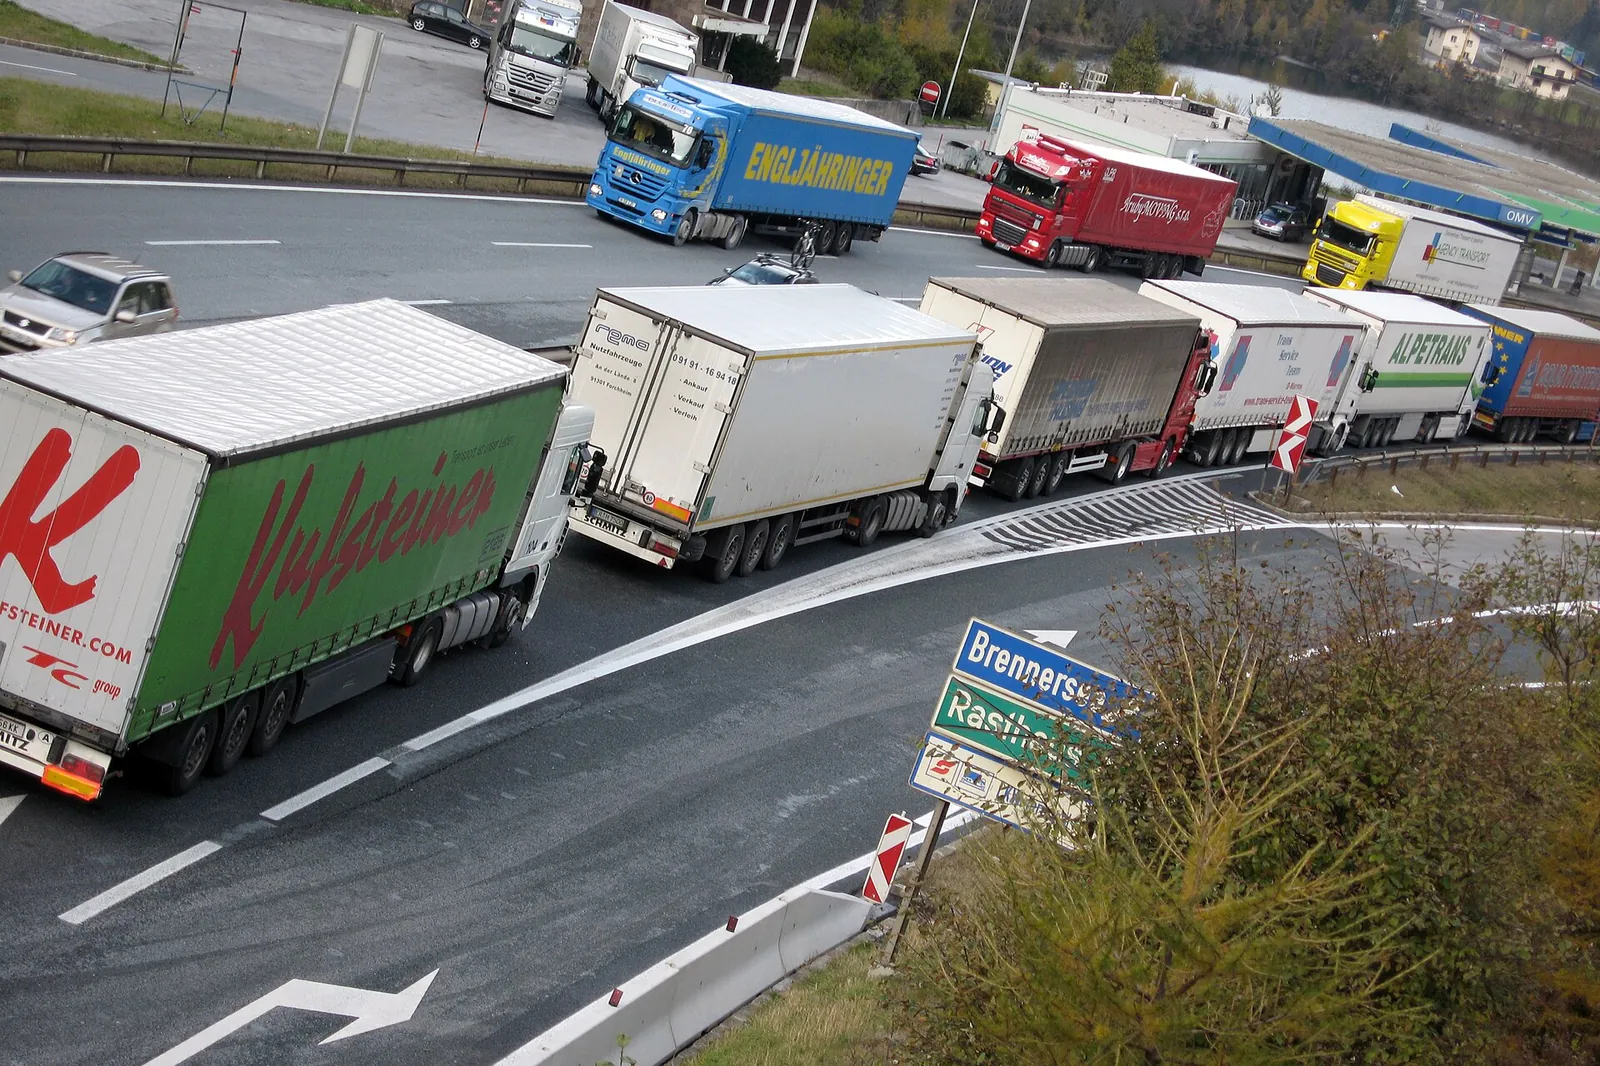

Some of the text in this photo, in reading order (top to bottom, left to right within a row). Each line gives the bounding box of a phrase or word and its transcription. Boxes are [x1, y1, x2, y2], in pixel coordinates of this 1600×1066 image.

[743, 142, 894, 197] ENGLJÄHRINGER
[1506, 210, 1534, 225] OMV
[595, 323, 650, 352] rema
[589, 342, 643, 367] Nutzfahrzeuge
[1387, 332, 1472, 366] ALPETRANS
[981, 353, 1013, 374] ION
[683, 378, 708, 393] Ankauf
[705, 367, 715, 377] 16
[715, 371, 726, 381] 94
[727, 376, 737, 386] 18
[678, 394, 705, 409] Verkauf
[673, 407, 698, 421] Verleih
[583, 514, 628, 538] SCHMITZ
[207, 450, 497, 672] Kufsteiner
[92, 679, 121, 701] group
[41, 732, 51, 743] A
